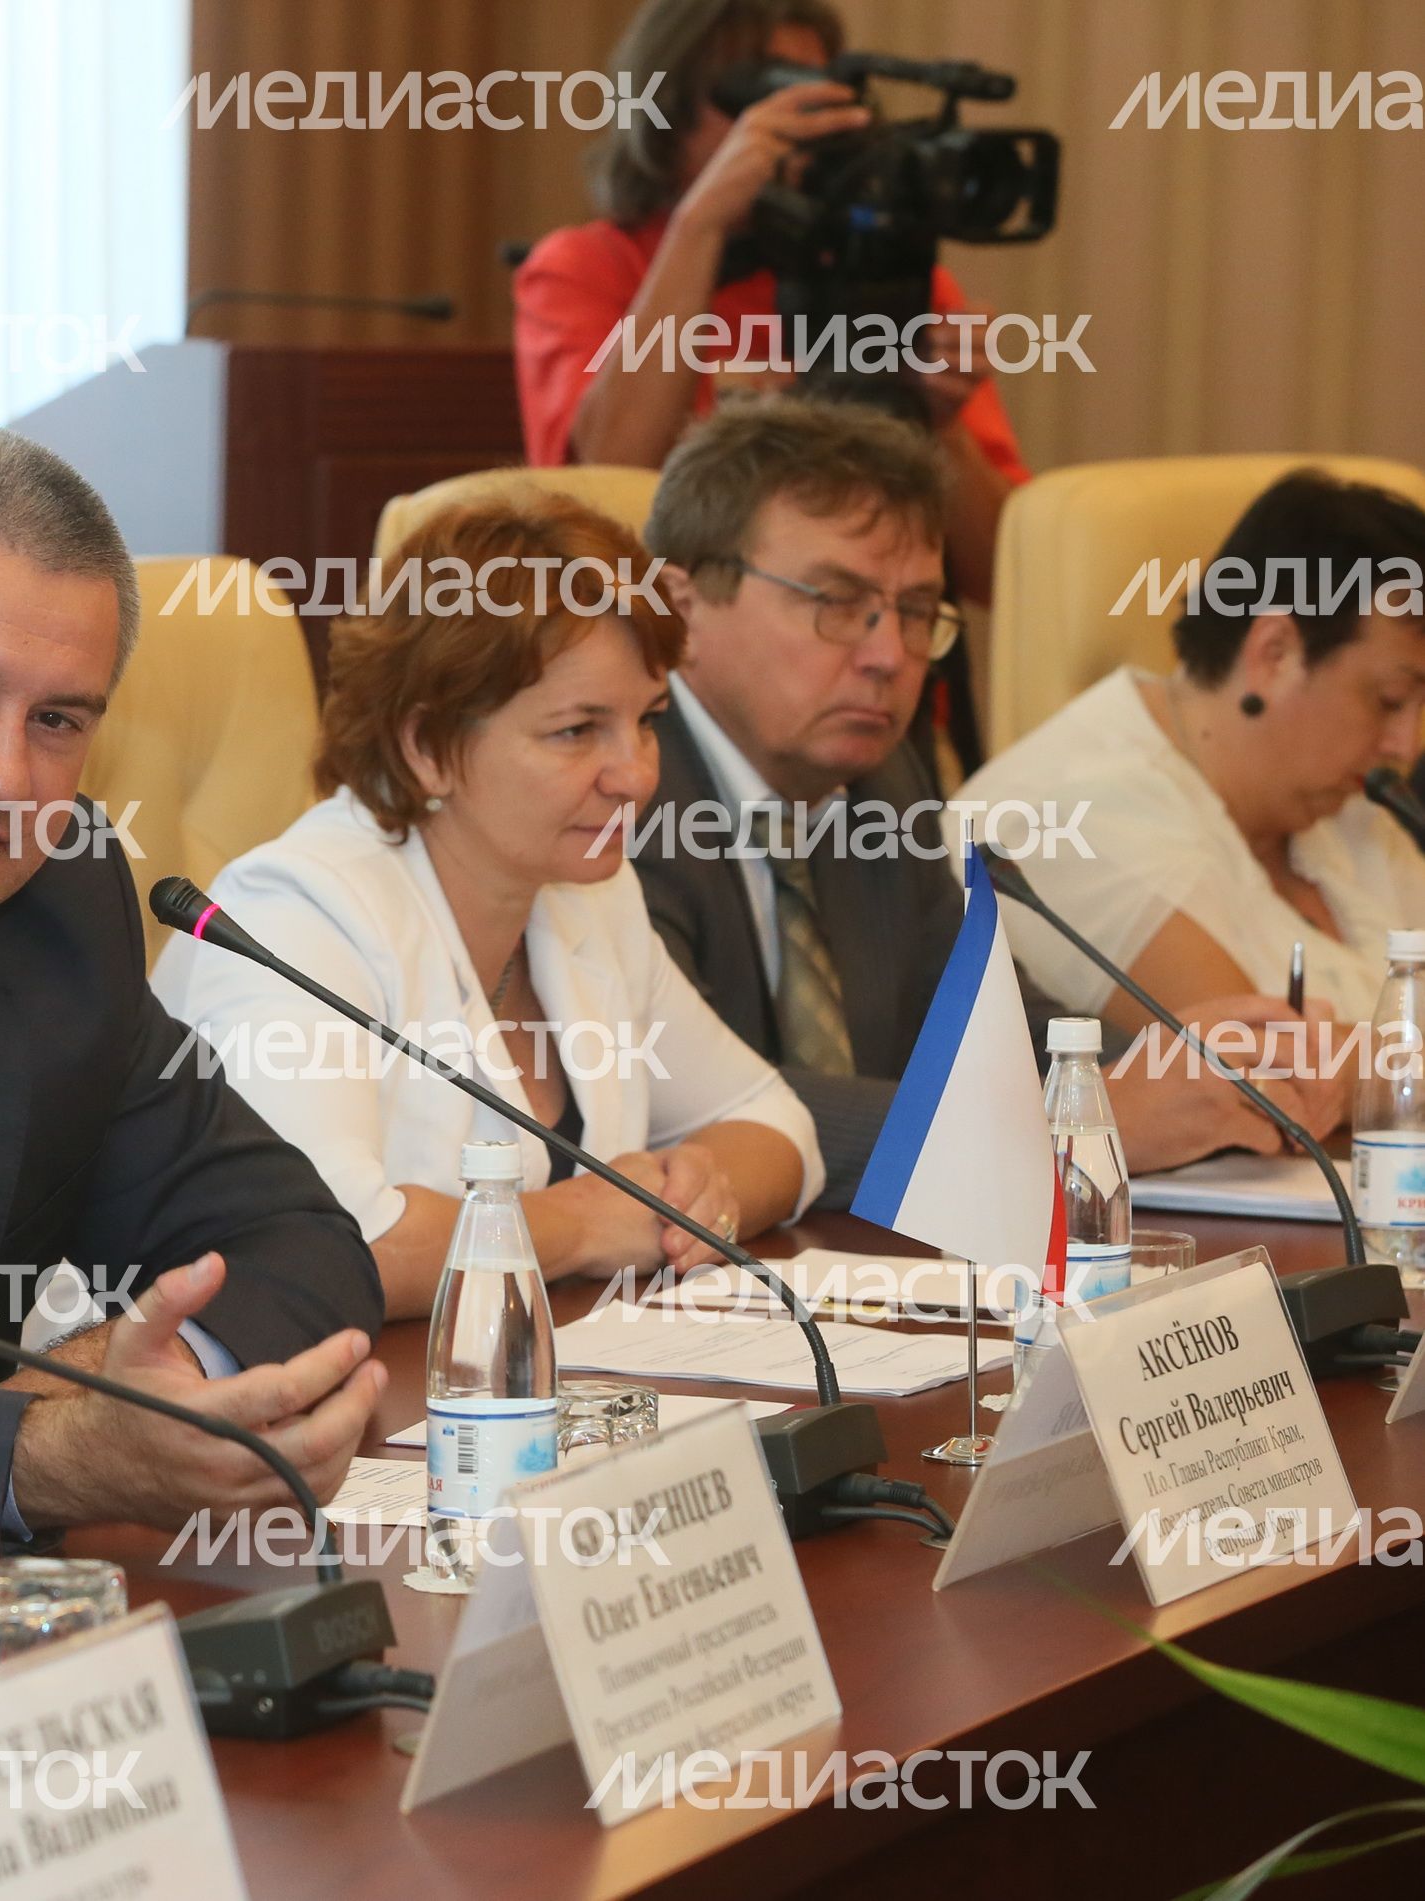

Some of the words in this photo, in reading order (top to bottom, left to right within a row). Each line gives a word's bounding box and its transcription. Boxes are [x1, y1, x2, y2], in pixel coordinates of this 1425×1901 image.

[1137, 1315, 1240, 1382] АКСЁНОВ
[1119, 1398, 1192, 1459] Сергей
[1185, 1370, 1297, 1430] Валерьевич
[1169, 1462, 1208, 1488] Главы
[1204, 1436, 1271, 1473] Республики
[1267, 1424, 1306, 1454] Крым,
[1227, 1477, 1268, 1508] Совета
[1267, 1458, 1324, 1493] министров
